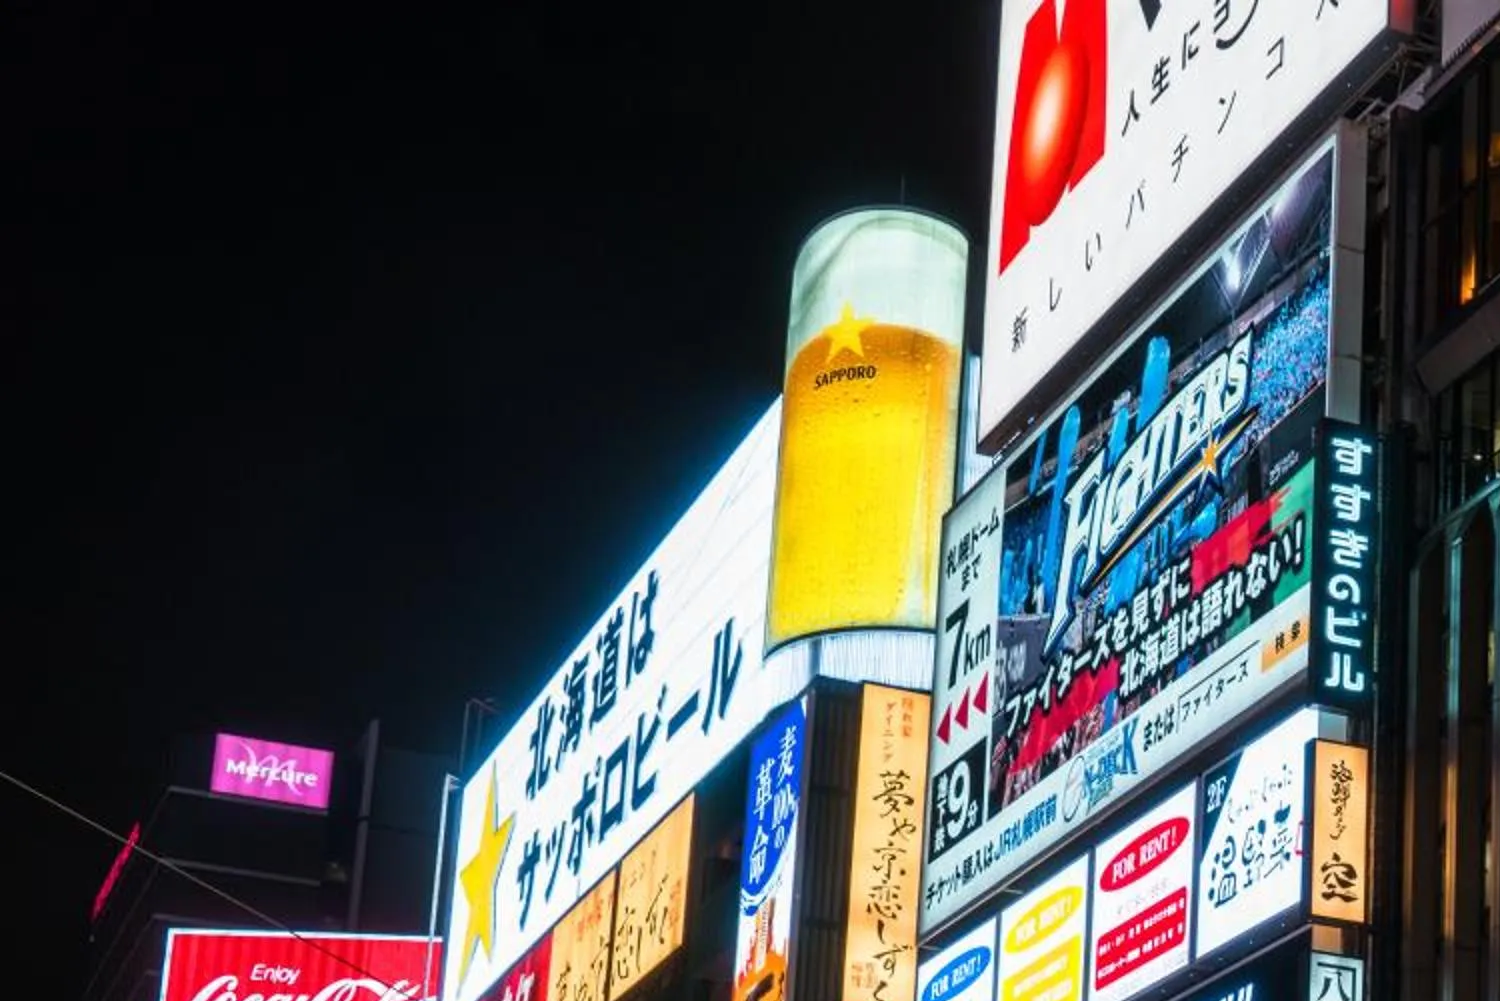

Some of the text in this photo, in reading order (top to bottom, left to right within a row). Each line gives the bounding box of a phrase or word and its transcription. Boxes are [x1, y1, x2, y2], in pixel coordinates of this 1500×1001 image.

[814, 364, 877, 390] SAPPORO
[1042, 328, 1254, 662] FIGHTERS
[946, 508, 1000, 578] 札幌ドーム
[1325, 436, 1373, 693] すすきのビル
[960, 560, 981, 592] まで
[1119, 518, 1306, 697] 北海道は語れない!
[1006, 558, 1191, 738] ファイターズを見ずに
[525, 568, 661, 801] 北海道は
[1180, 660, 1250, 723] ファイターズ
[225, 755, 319, 788] Mercure
[516, 614, 745, 932] サッポロビール
[1206, 775, 1228, 814] 2F
[1111, 825, 1177, 884] FOR RENT!
[1014, 920, 1038, 946] FOR
[250, 963, 302, 986] Enjoy
[931, 954, 982, 1001] FOR RENT!
